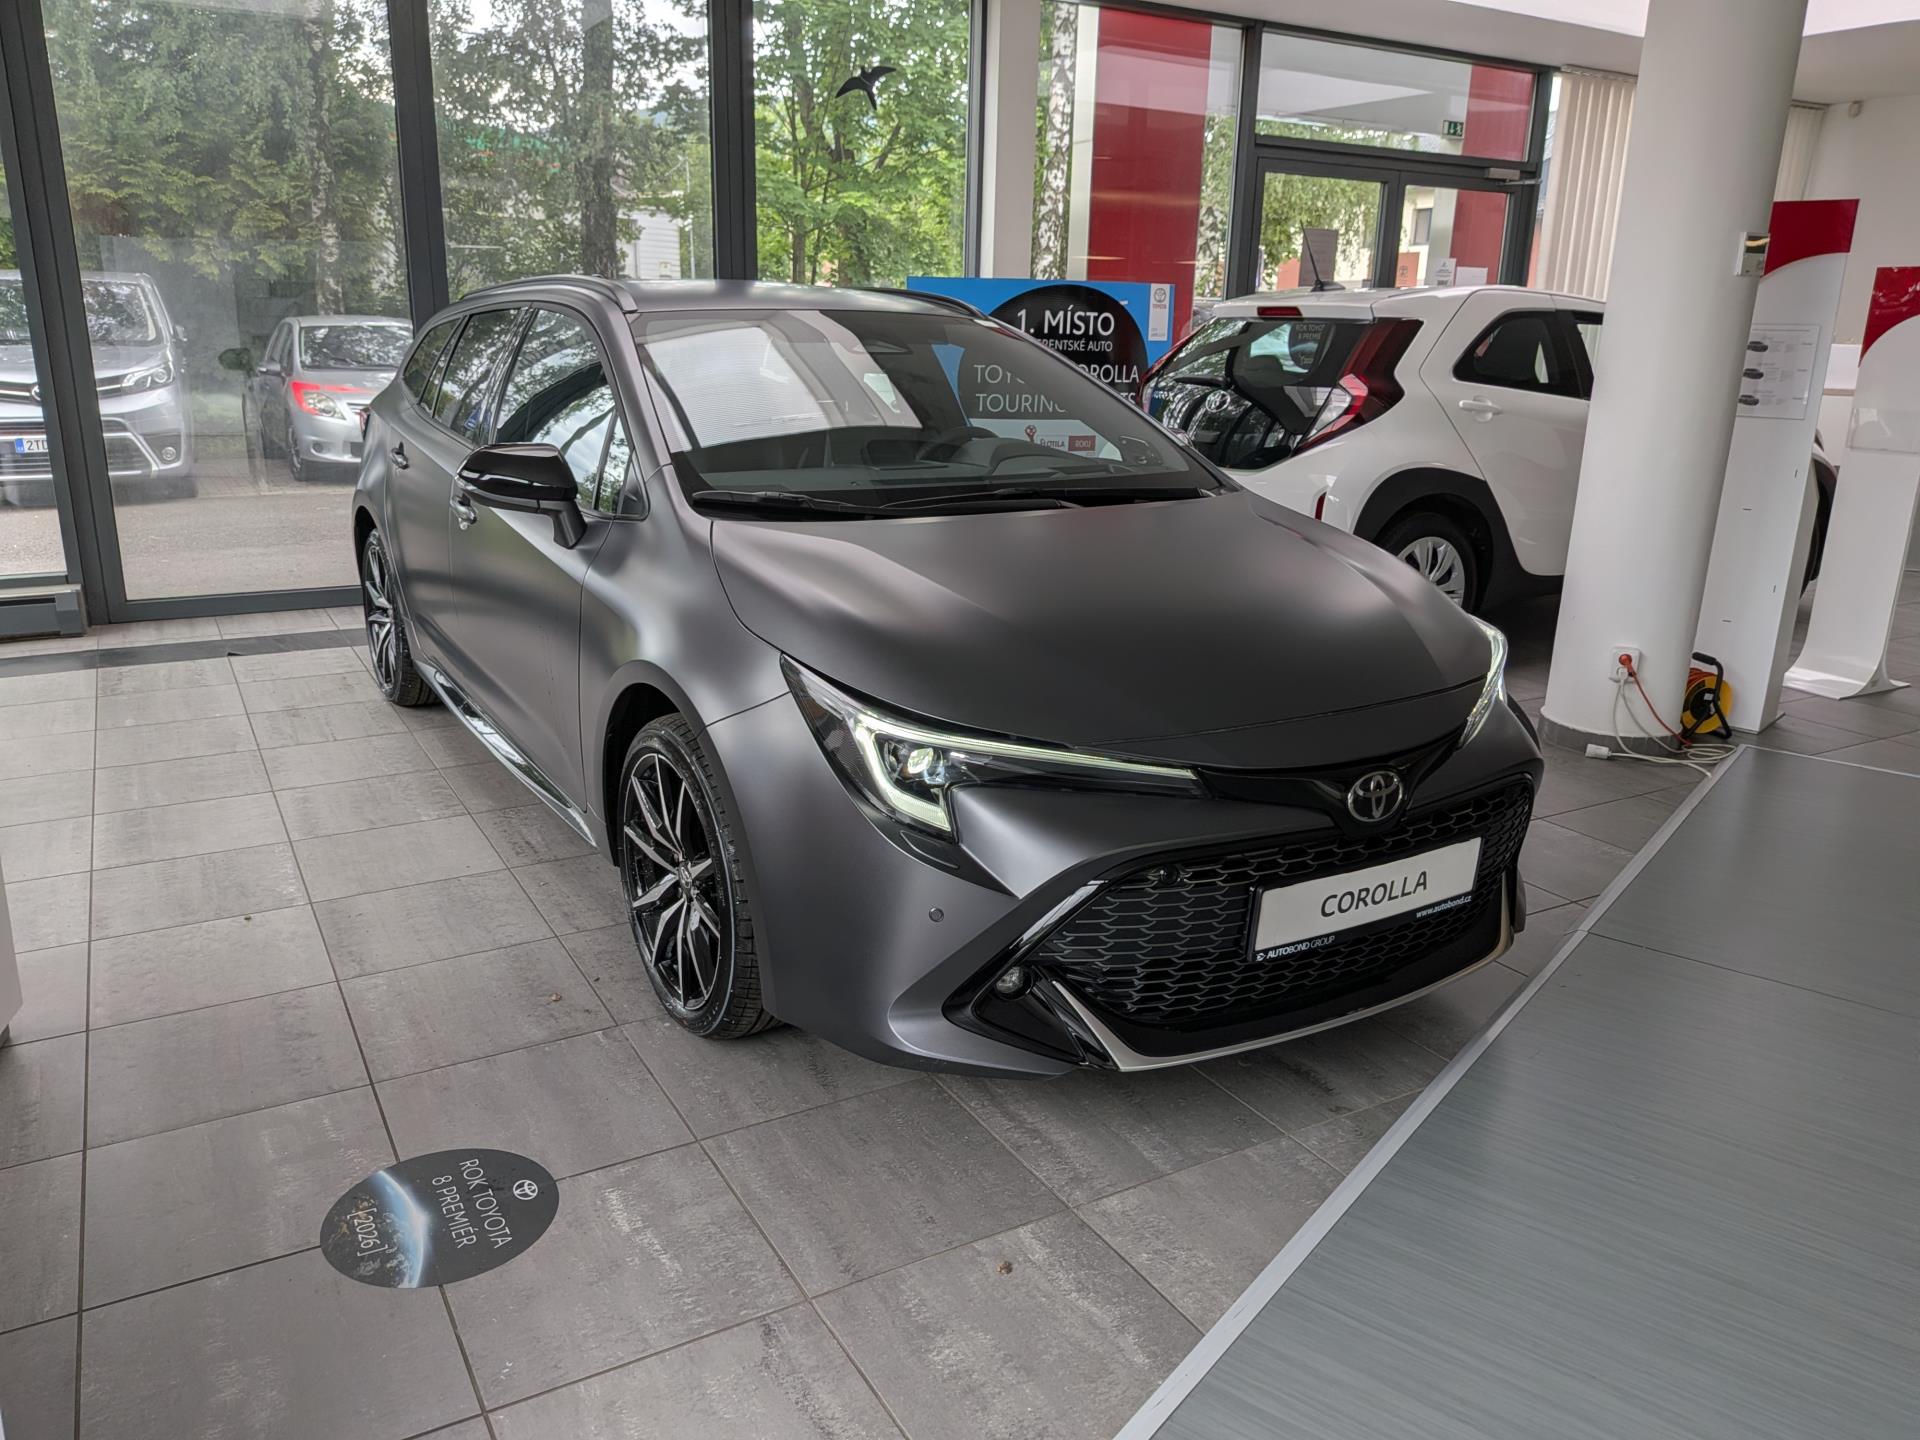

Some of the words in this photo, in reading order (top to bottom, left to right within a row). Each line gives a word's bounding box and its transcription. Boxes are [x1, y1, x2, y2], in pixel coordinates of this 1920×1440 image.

[1017, 308, 1035, 334] 1.
[1043, 304, 1115, 336] MÍSTO
[1038, 337, 1085, 352] RENTSKÉ
[1087, 340, 1114, 352] AUTO
[1079, 364, 1140, 383] ROLLA
[1320, 870, 1427, 917] COROLLA
[1416, 895, 1472, 918] www.autobond.cz
[1266, 941, 1310, 959] AUTOBOND
[1310, 935, 1335, 948] GROUP
[432, 1175, 452, 1186] 8
[459, 1158, 489, 1190] ROK
[436, 1186, 479, 1248] PREMIÉR
[472, 1188, 513, 1248] TOYOTA
